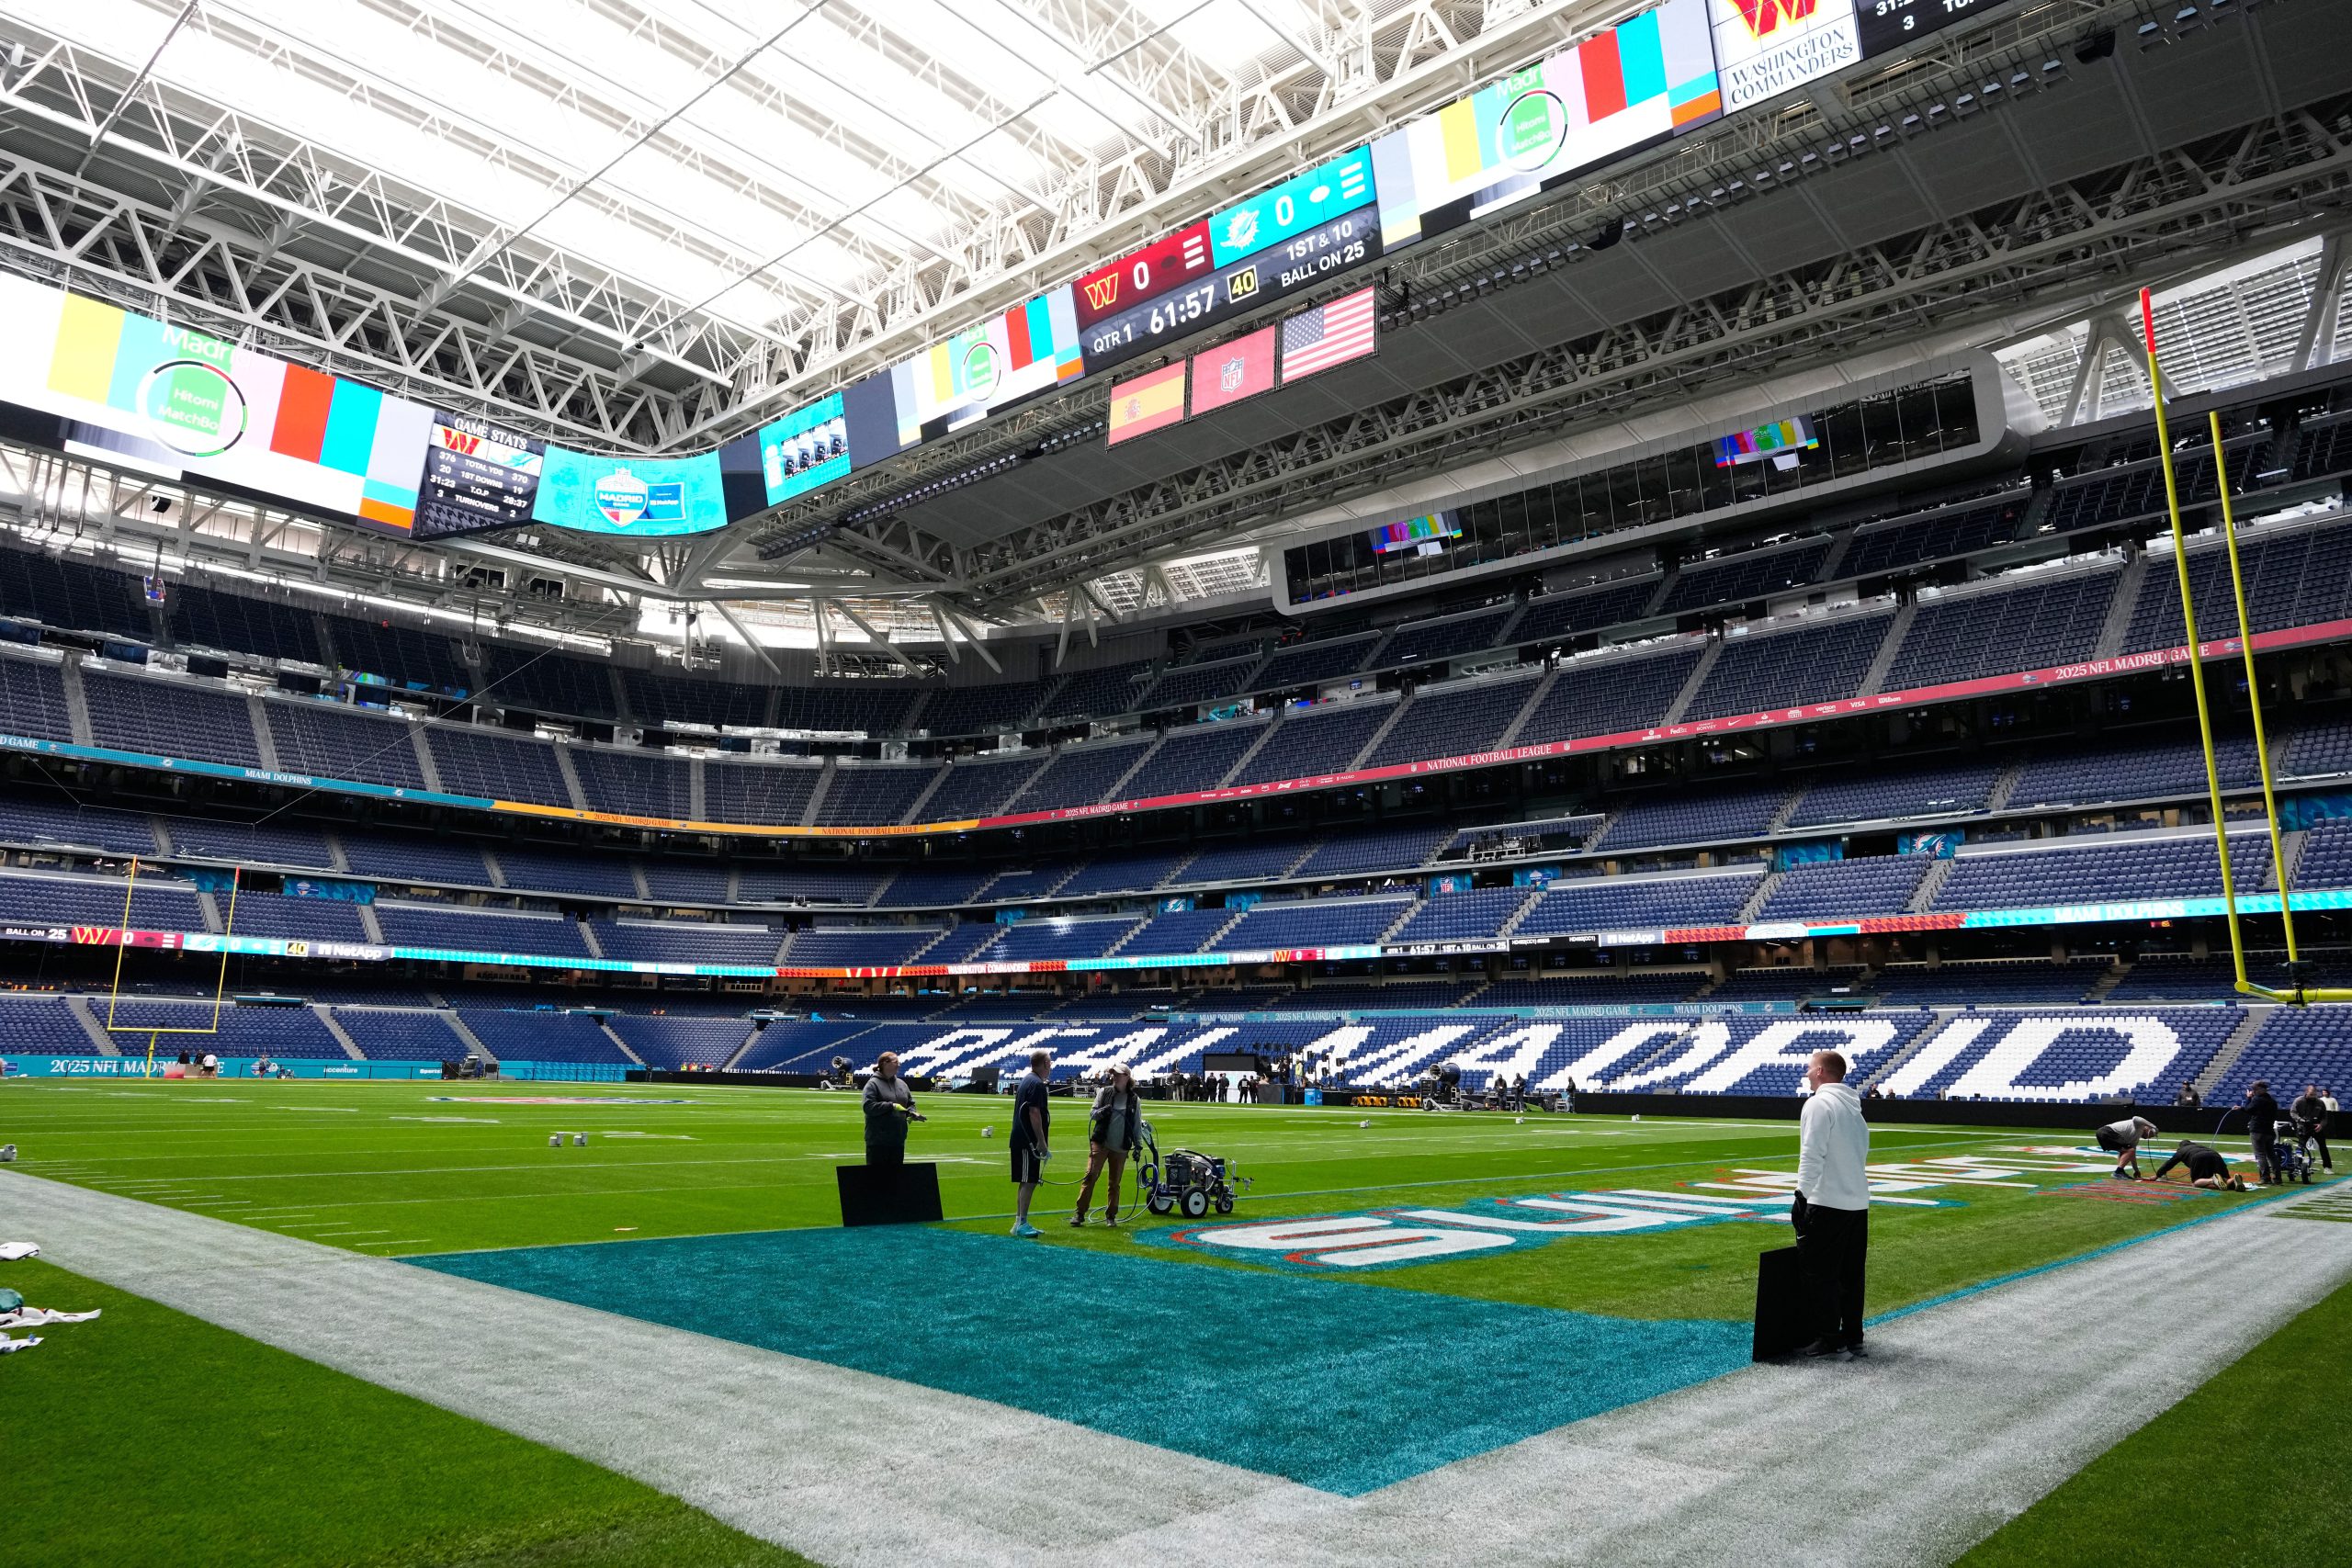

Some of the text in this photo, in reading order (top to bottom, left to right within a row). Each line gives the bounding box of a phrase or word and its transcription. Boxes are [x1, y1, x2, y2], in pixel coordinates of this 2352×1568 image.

[1903, 16, 1915, 30] 3
[1733, 26, 1845, 85] WASHINGTON
[1731, 42, 1853, 104] COMMANDERS
[1275, 194, 1294, 227] 0
[1286, 220, 1352, 261] 1ST & 10
[1281, 242, 1365, 288] BALL ON 25
[1133, 261, 1150, 290] 0
[1232, 275, 1255, 297] 40
[1093, 285, 1215, 354] QTR 1 61:57
[1224, 370, 1242, 388] NFL
[454, 418, 528, 450] GAME STATS
[439, 451, 528, 484] 376 TOTAL YDS 370
[439, 464, 524, 495] 20 1ST DOWNS 19
[429, 474, 456, 489] 31:23
[503, 495, 528, 509] 28:37
[598, 492, 643, 504] MADRID
[436, 490, 516, 518] 3 TURNOVERS 2
[2055, 644, 2211, 680] 2025 NFL MADRID GAE
[1878, 695, 1902, 704] Wilson
[9, 737, 39, 750] GAME
[1427, 744, 1552, 771] NATIONAL FOOTBALL LEAGUE
[244, 769, 312, 785] MIAMI DOLPHINS
[1065, 808, 1080, 817] 2025
[1091, 805, 1112, 814] MADRID
[1112, 802, 1128, 811] GAME
[594, 813, 610, 821] 2025
[625, 818, 650, 826] MADRID
[1442, 884, 1453, 893] NFL
[2053, 902, 2186, 922] MIAMI DOLPHINS
[6, 928, 29, 936] BALL
[48, 929, 67, 940] 25
[123, 931, 134, 944] 0
[1618, 933, 1656, 943] NetApp
[288, 942, 305, 954] 40
[334, 944, 382, 960] NetApp
[1410, 944, 1435, 955] 61:57
[1462, 943, 1472, 952] 10
[1496, 942, 1507, 950] 25
[1295, 951, 1303, 960] 0
[948, 963, 1029, 974] WASHINGTON COMMANDERS
[1275, 1012, 1292, 1021] 2025
[1305, 1011, 1330, 1021] MADRID
[1331, 1011, 1351, 1020] GAME
[1533, 1006, 1630, 1017] 2025 NFL MADRID GAME
[1674, 1004, 1743, 1014] MIAMI DOLPHINS
[50, 1060, 178, 1074] 2025 NFL MADR
[856, 1018, 2179, 1102] REAL MADRID
